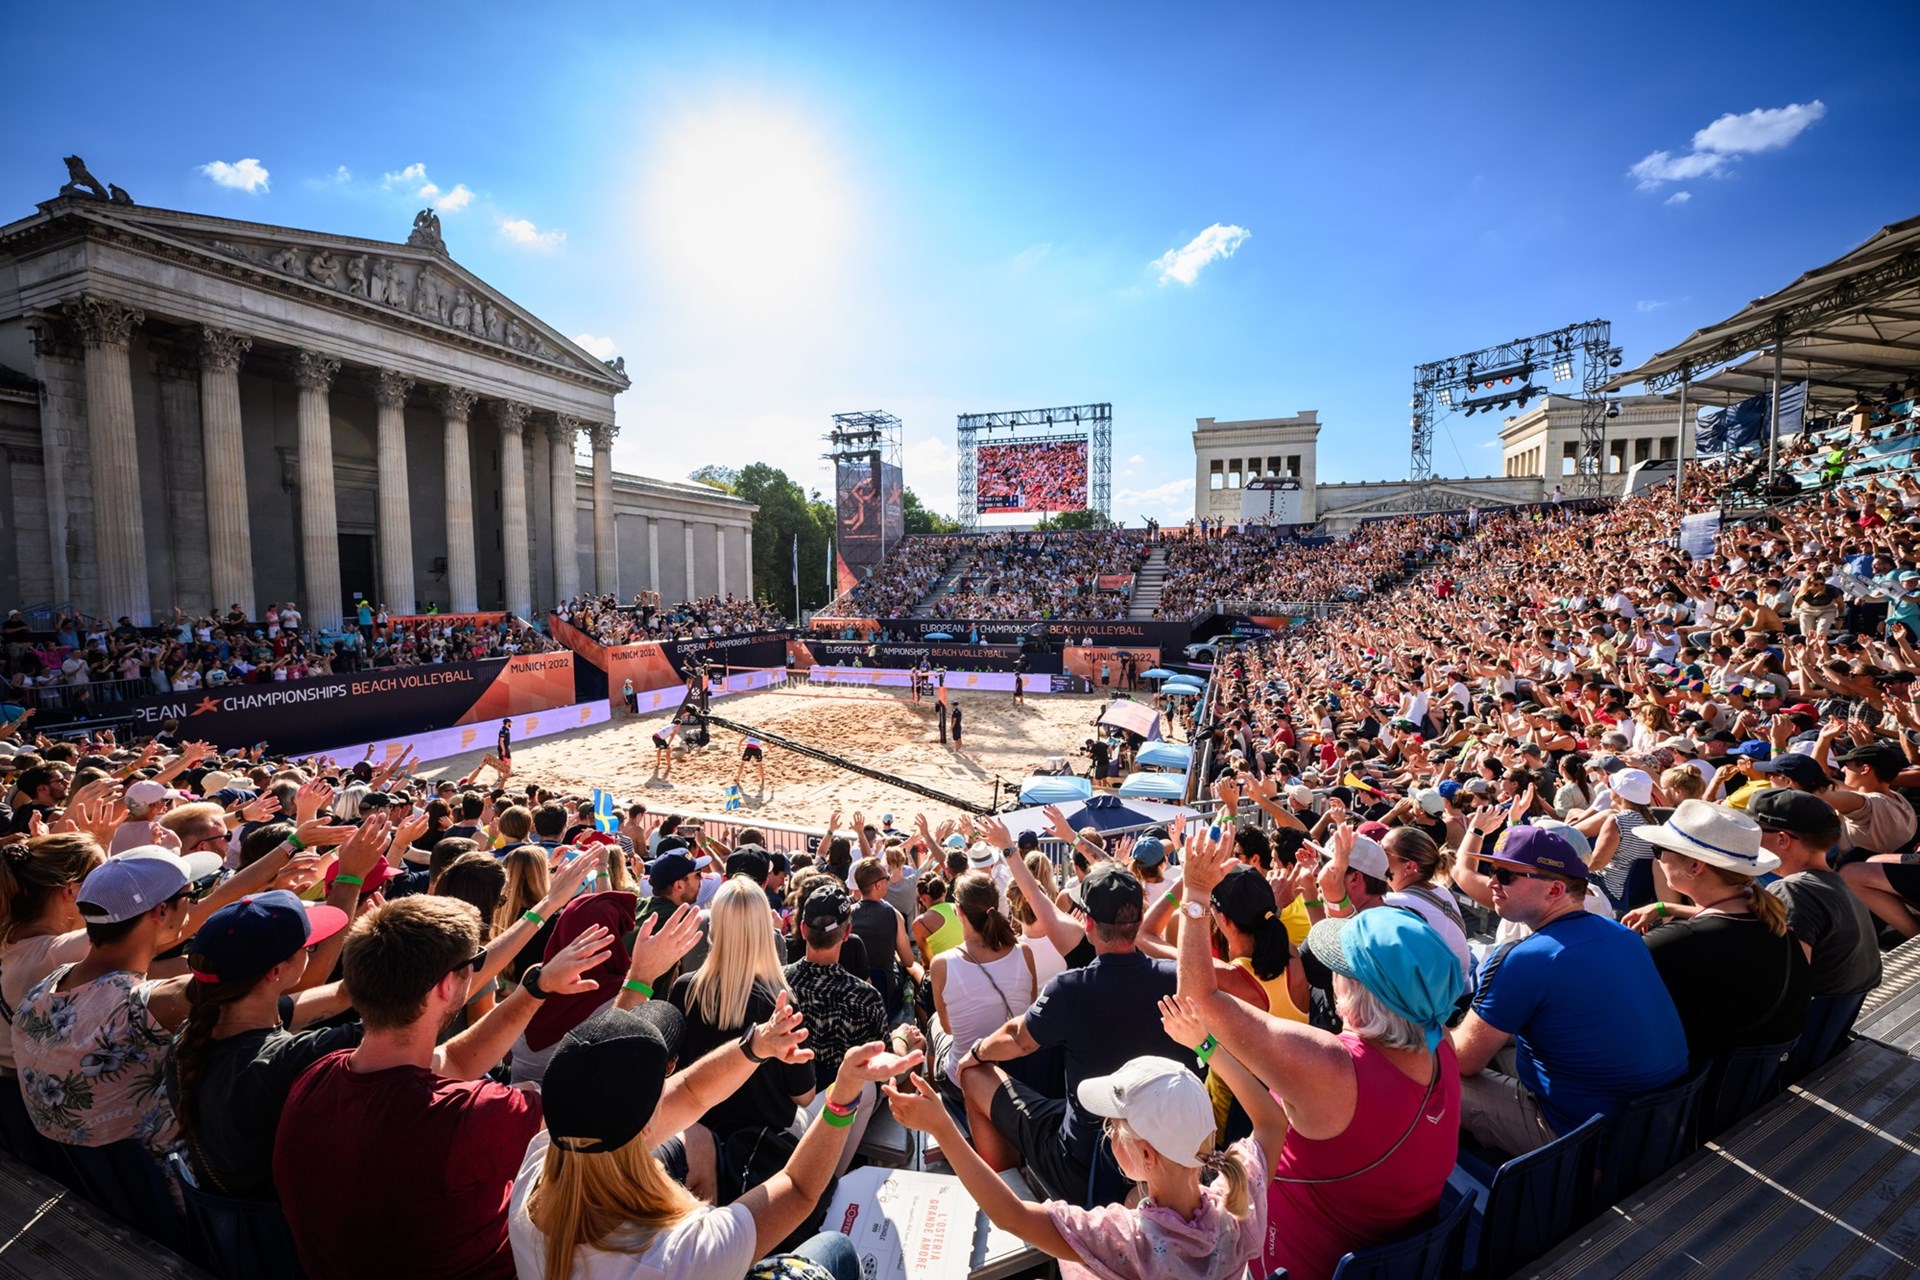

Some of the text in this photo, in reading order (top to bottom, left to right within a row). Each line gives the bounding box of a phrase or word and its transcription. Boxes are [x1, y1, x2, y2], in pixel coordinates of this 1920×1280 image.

[920, 624, 964, 633] EUROPEAN
[1051, 625, 1144, 636] BEACH VOLLEYBALL
[715, 637, 751, 649] CHAMPIONSHIPS
[612, 649, 656, 661] MUNICH 2022
[826, 645, 862, 654] EUROPEAN
[931, 648, 1008, 659] BEACH VOLLEYBALL
[511, 658, 569, 674] MUNICH 2022
[351, 669, 474, 696] BEACH VOLLEYBALL
[223, 684, 347, 712] CHAMPIONSHIPS
[923, 1199, 939, 1234] GRANDE
[929, 1213, 948, 1261] L'OSTERIA
